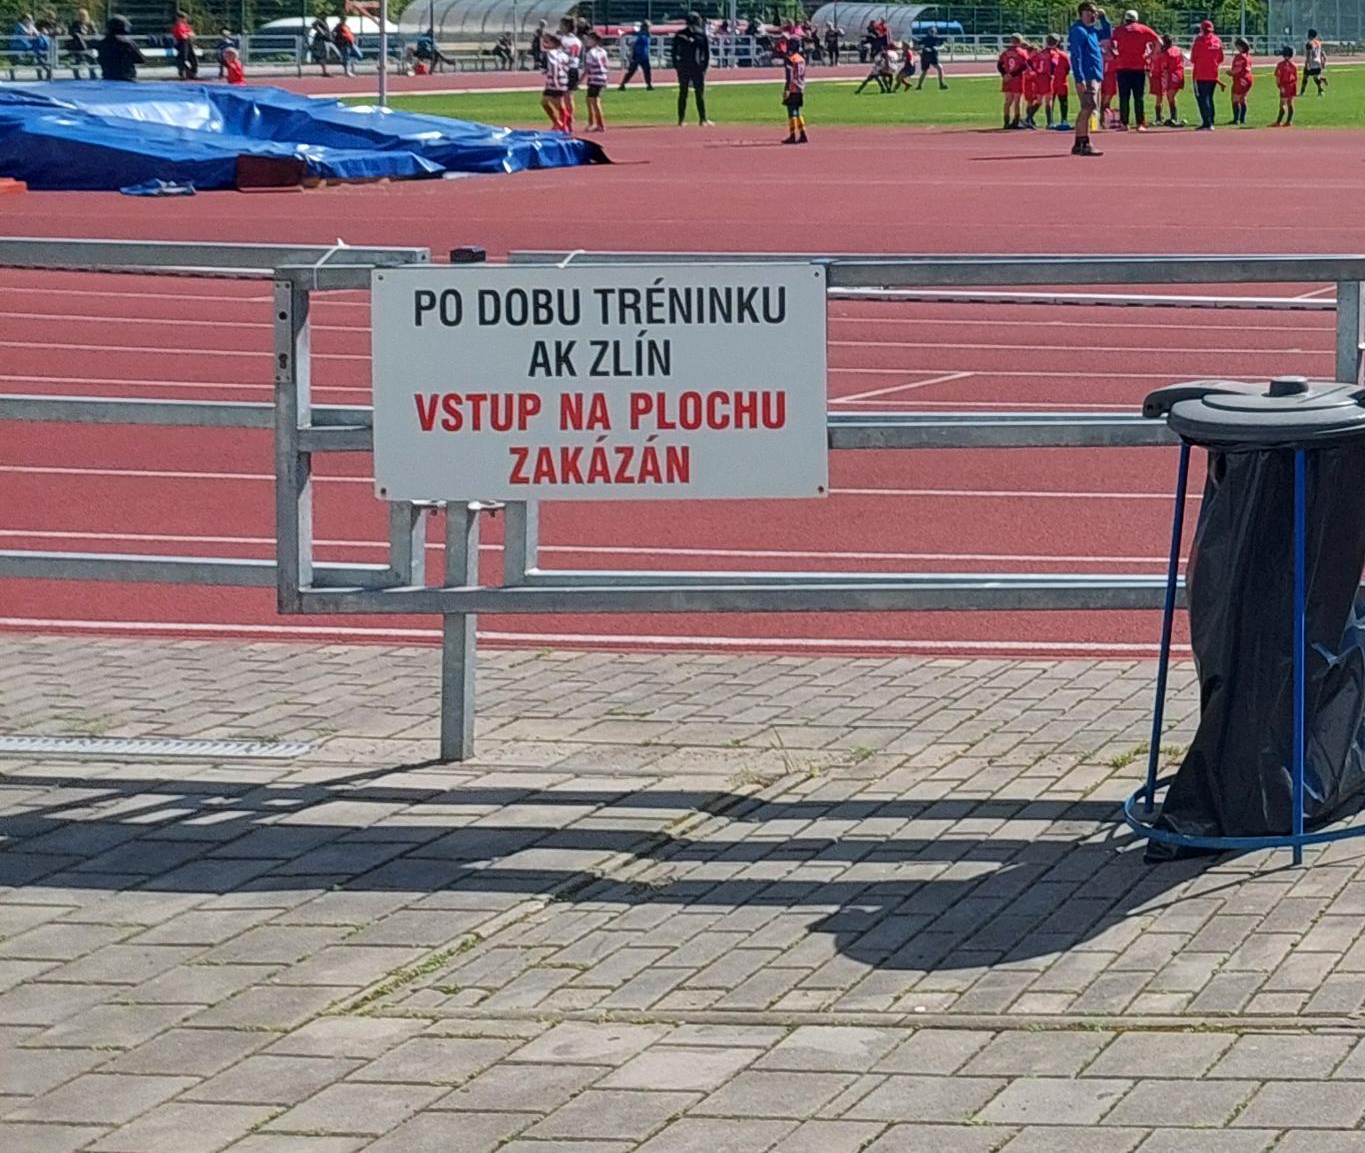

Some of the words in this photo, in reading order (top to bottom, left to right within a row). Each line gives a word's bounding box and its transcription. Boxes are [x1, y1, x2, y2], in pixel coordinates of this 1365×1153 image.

[414, 288, 463, 327] PO
[478, 287, 581, 327] DOBU
[593, 277, 786, 325] TRÉNINKU
[528, 340, 577, 377] AK
[589, 329, 671, 377] ZLÍN
[414, 393, 542, 432] VSTUP
[559, 392, 612, 431] NA
[630, 390, 786, 431] PLOCHU
[509, 434, 690, 485] ZAKÁZÁN
